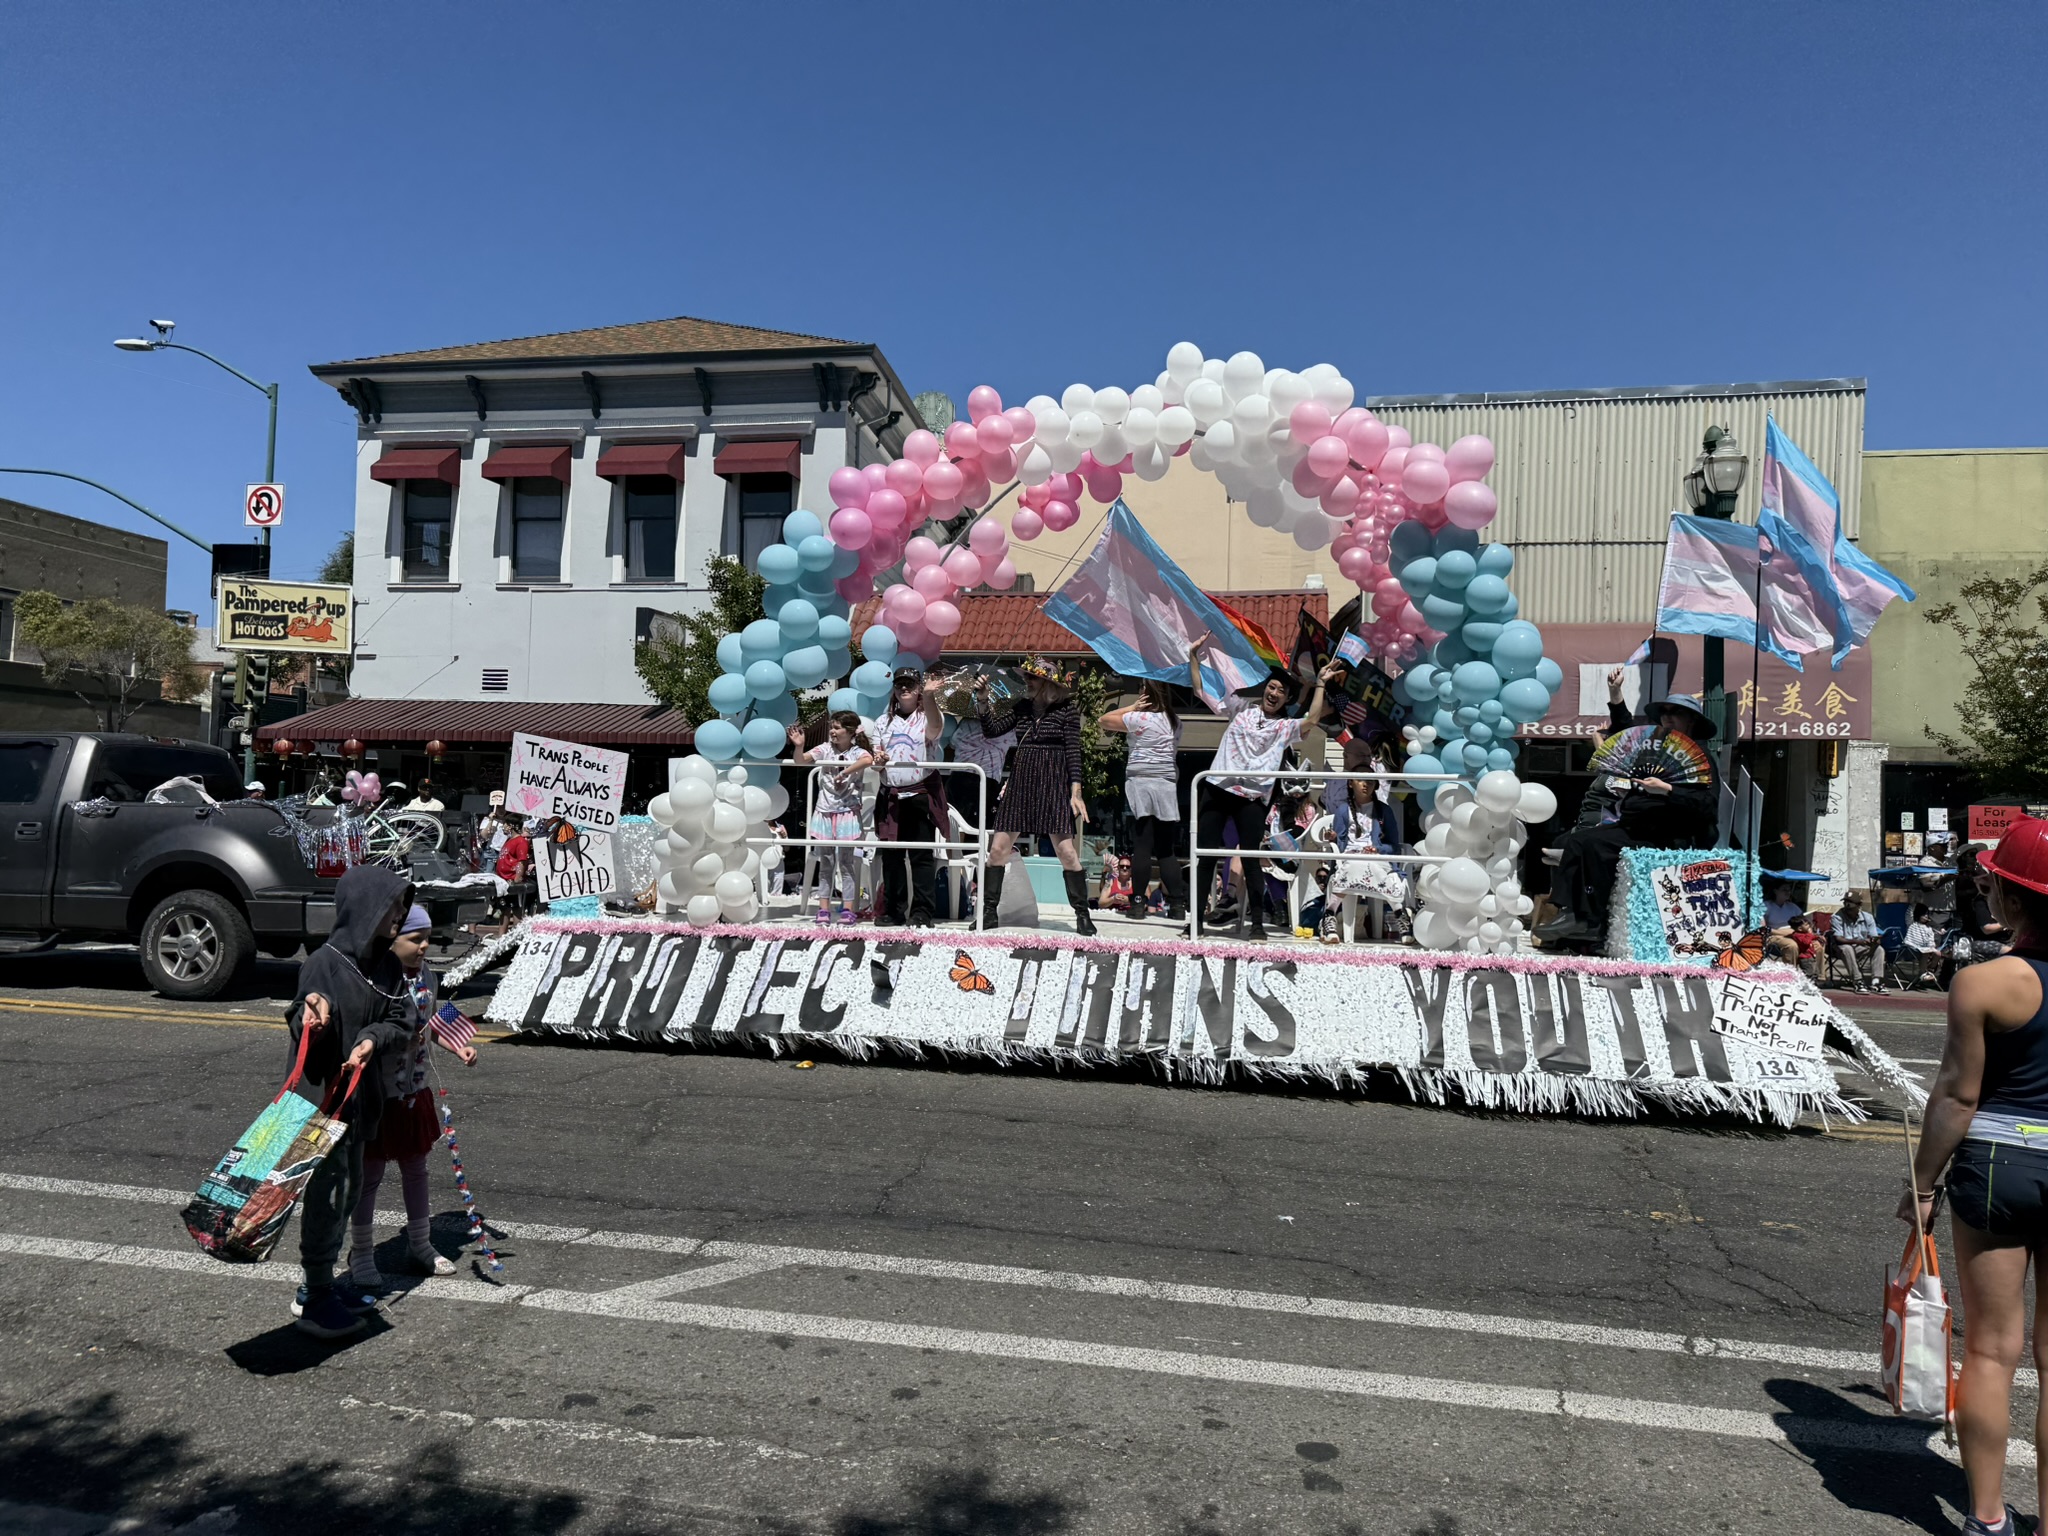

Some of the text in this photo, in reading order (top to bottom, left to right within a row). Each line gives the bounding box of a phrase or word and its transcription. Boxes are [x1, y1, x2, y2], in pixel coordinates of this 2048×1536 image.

[239, 585, 258, 597] The
[225, 590, 346, 618] Pampered Pup
[235, 621, 285, 637] HOT DOGS
[243, 615, 278, 625] Deluxe
[1692, 679, 1858, 719] 舟美食
[1522, 722, 1599, 736] Resta
[1755, 721, 1851, 736] 521-6862
[526, 741, 609, 774] TRANS PEOPLE
[520, 770, 552, 790] HAVE
[550, 765, 610, 800] ALWAYS
[1984, 807, 2006, 816] For
[1976, 818, 2012, 827] Lease
[545, 867, 610, 900] LOVED
[1696, 910, 1742, 929] KIDS
[520, 941, 554, 956] 134
[522, 933, 1734, 1083] PROTECT TRANS YOUTH
[1715, 1016, 1759, 1040] Trans
[1756, 1060, 1798, 1077] 134
